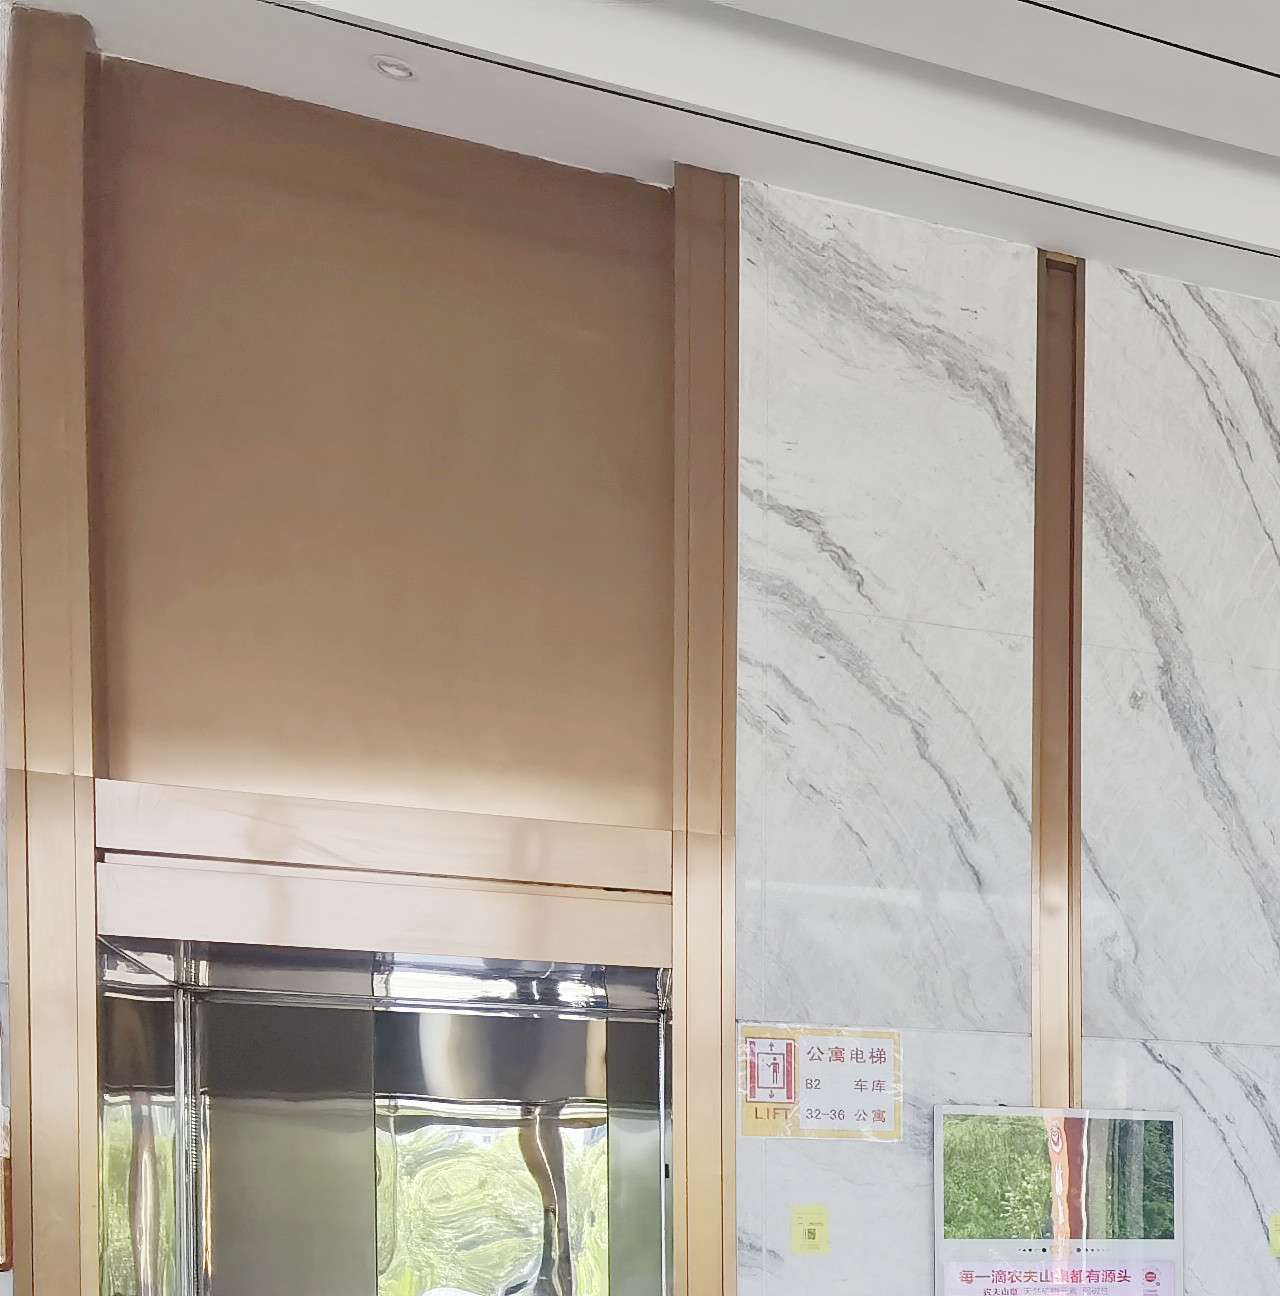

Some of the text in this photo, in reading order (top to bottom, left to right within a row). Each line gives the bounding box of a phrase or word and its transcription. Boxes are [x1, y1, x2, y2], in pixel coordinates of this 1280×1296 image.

[806, 1045, 887, 1065] 公寓电梯
[805, 1078, 886, 1093] B2 车库
[754, 1107, 790, 1120] LIFT
[805, 1108, 887, 1123] 32-36 公寓
[960, 1268, 1132, 1285] 每一滴农夫山泉都有源头
